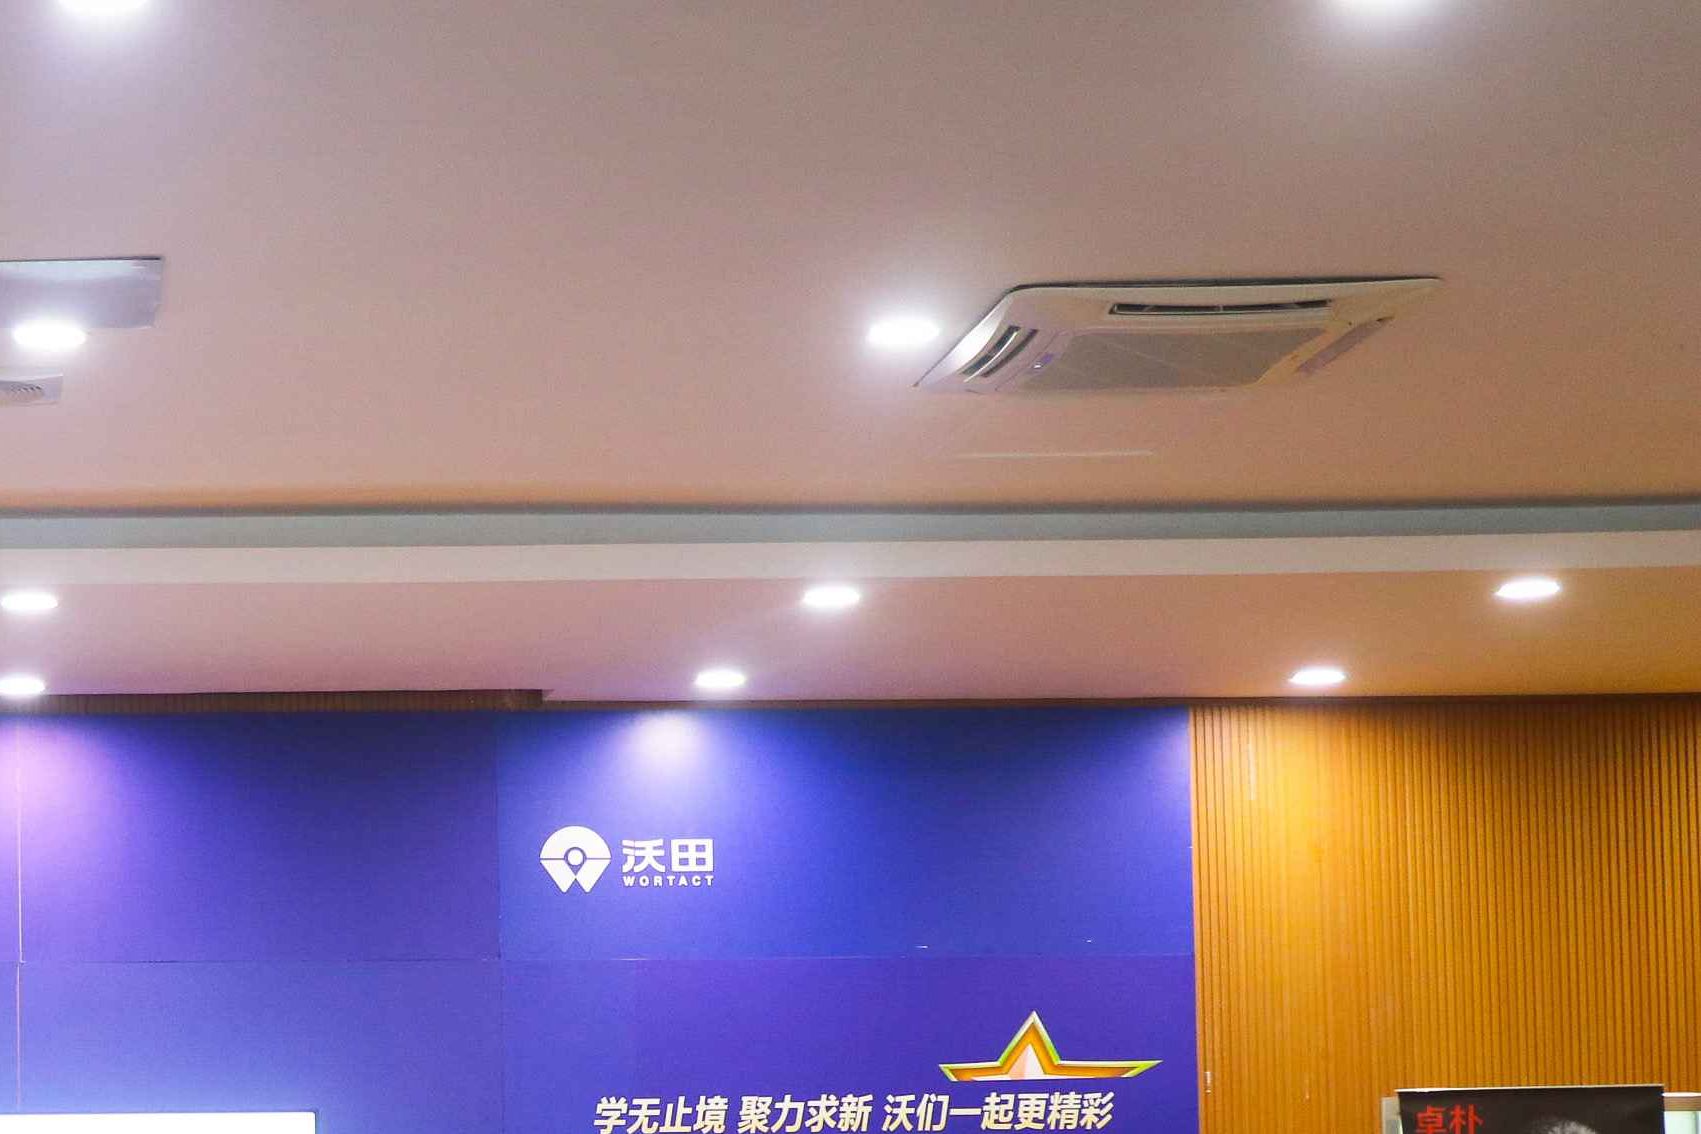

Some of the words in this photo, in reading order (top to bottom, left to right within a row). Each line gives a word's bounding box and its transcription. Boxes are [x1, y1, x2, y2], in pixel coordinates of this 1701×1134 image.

[621, 838, 714, 872] 沃田
[623, 874, 715, 887] WORTACT
[737, 1093, 874, 1134] 聚力求新
[882, 1091, 1115, 1133] 沃们一起更精彩
